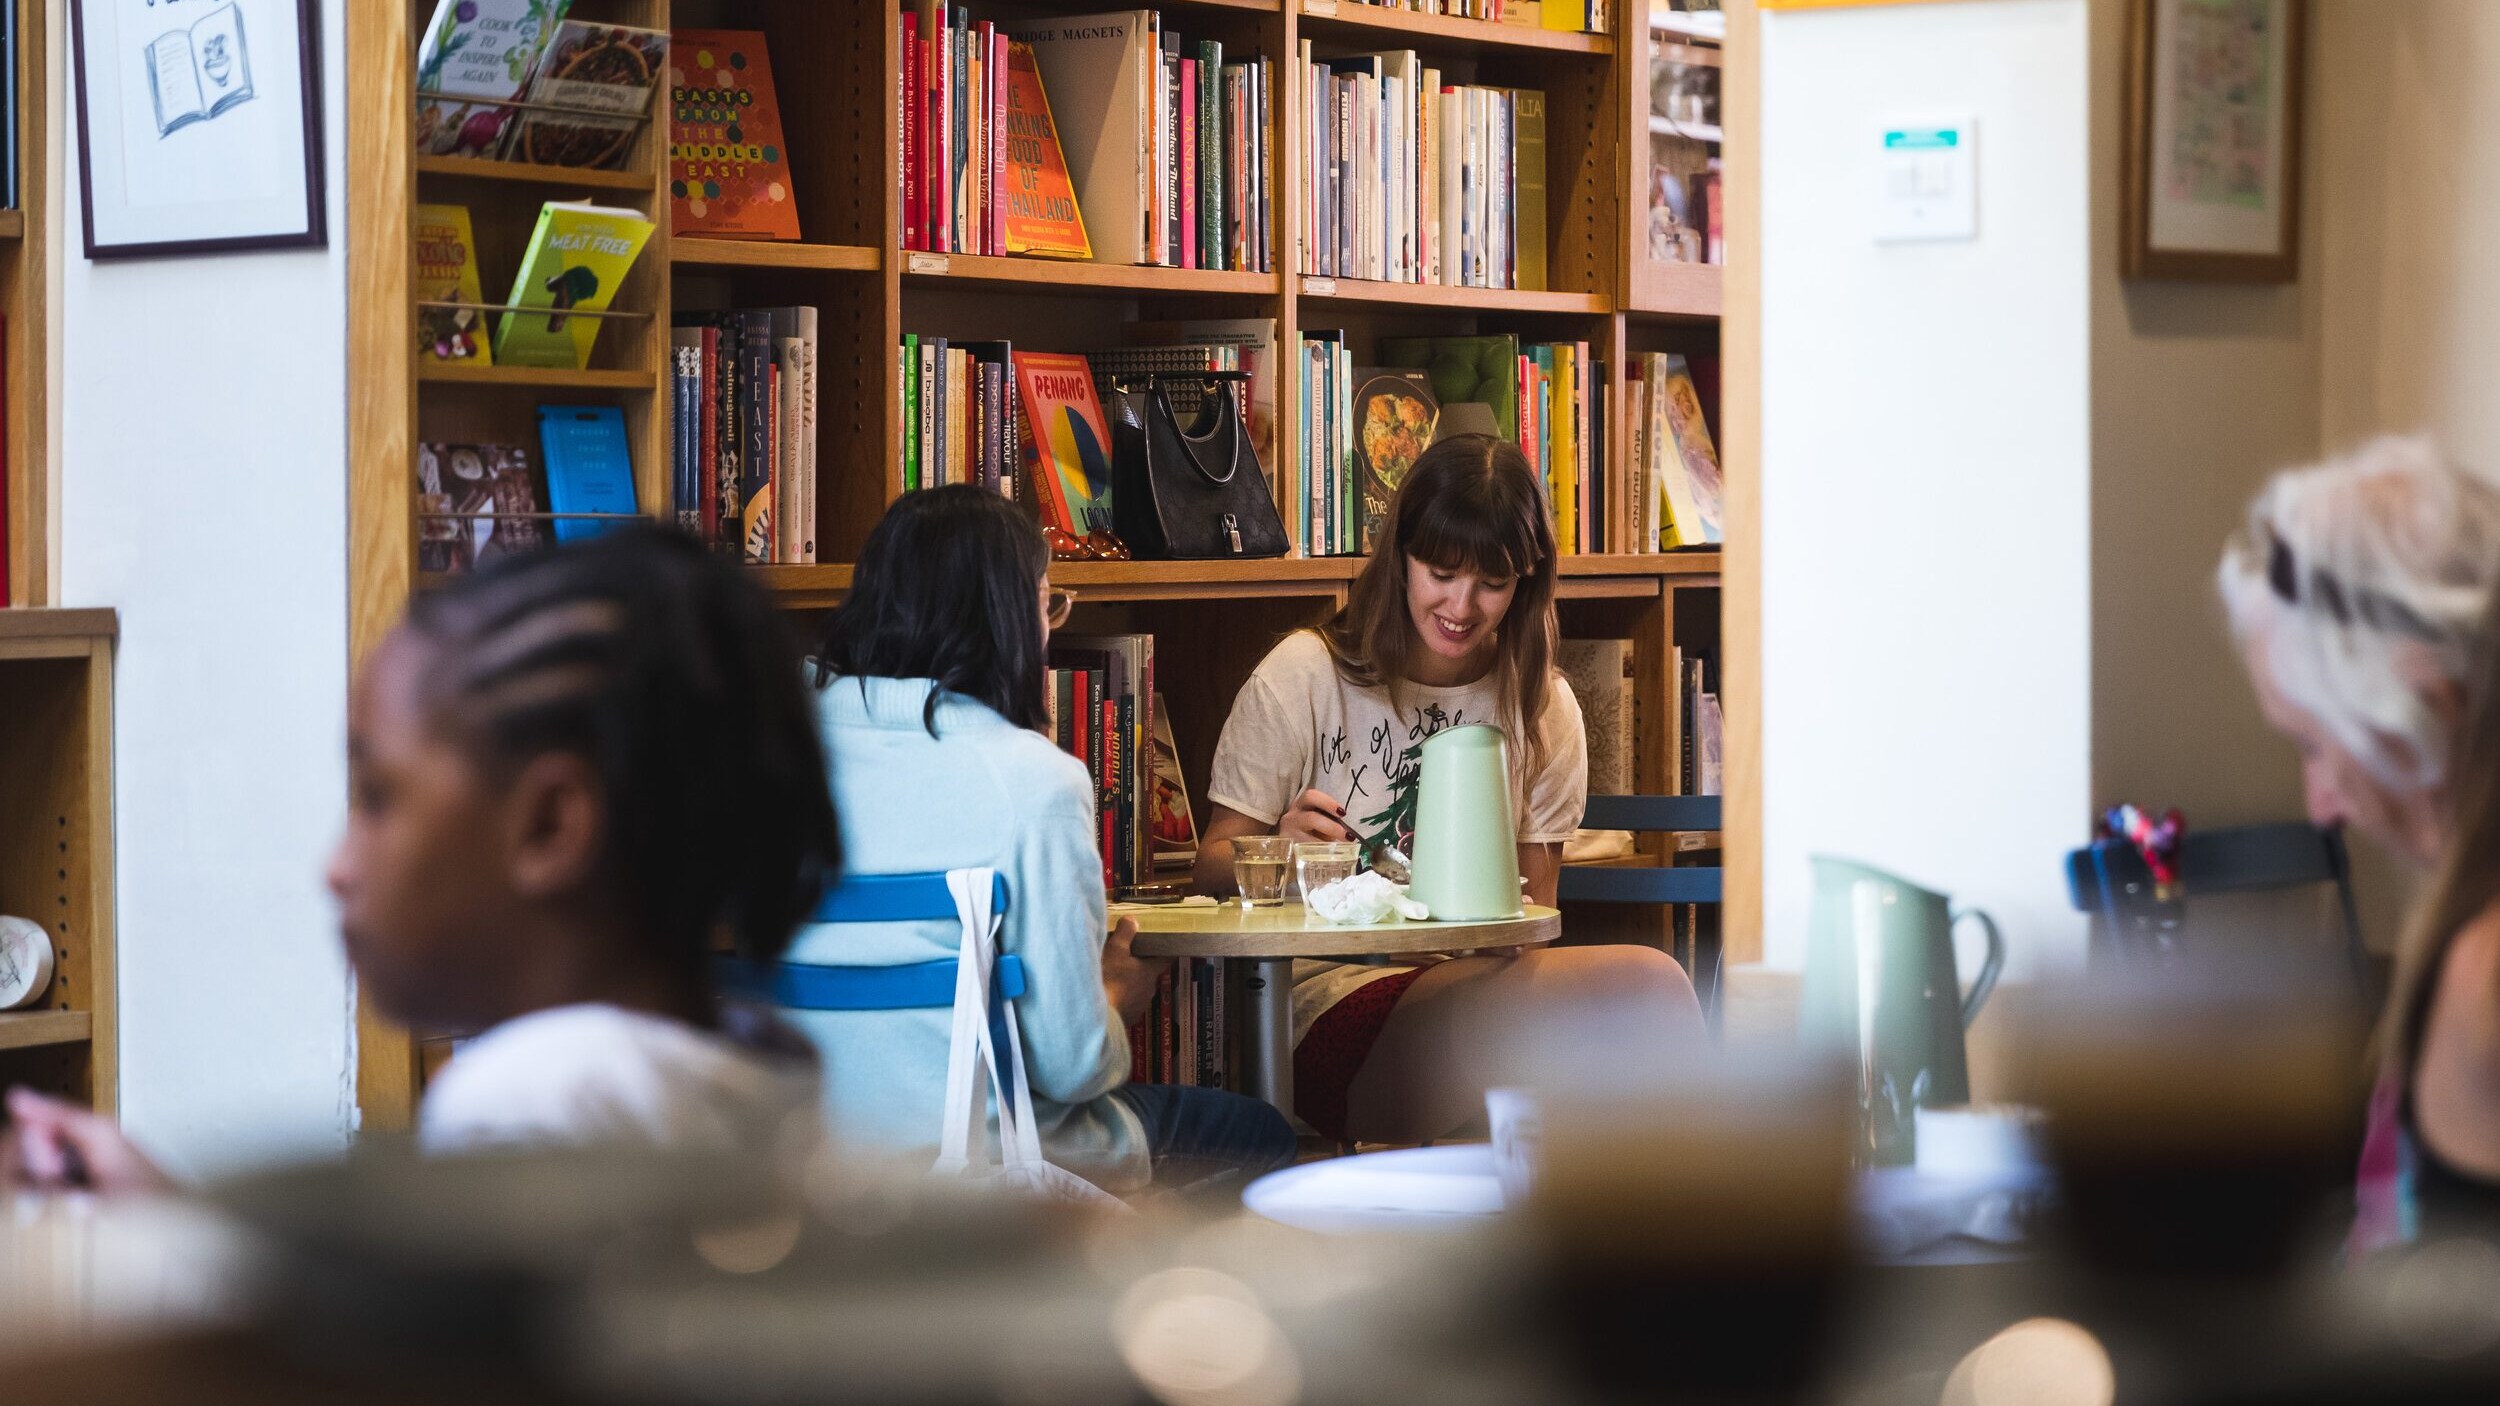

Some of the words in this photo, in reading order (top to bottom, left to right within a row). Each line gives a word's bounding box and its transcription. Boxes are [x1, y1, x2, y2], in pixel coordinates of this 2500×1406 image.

[479, 18, 513, 32] COOK
[1062, 26, 1124, 41] MAGNETS
[479, 36, 497, 48] TO
[907, 29, 915, 57] Same
[458, 51, 503, 66] INSPIRE
[459, 70, 499, 83] AGAIN
[907, 59, 915, 88] Same
[675, 90, 750, 104] EASTS
[1341, 91, 1349, 118] PETER
[1515, 99, 1543, 118] ALIA
[678, 109, 737, 122] FROM
[1007, 111, 1052, 139] NKING
[682, 128, 724, 140] THE
[905, 111, 914, 155] Different
[980, 119, 988, 170] Monsoon
[995, 103, 1006, 173] maenam
[1169, 107, 1178, 165] Northern
[1341, 120, 1349, 162] HOWARD
[670, 145, 761, 159] MIDDLE
[1184, 115, 1194, 216] MANDALAY
[688, 166, 745, 179] EAST
[905, 162, 914, 175] by
[1020, 167, 1039, 191] OF
[980, 172, 988, 208] Winds
[1169, 167, 1178, 222] Thailand
[548, 235, 592, 251] MEAT
[590, 236, 633, 255] FREE
[726, 360, 735, 442] Salmagundi
[1034, 374, 1085, 401] PENANG
[1314, 378, 1322, 408] SOUTH
[753, 356, 762, 477] FEAST
[925, 380, 933, 435] busaba
[990, 370, 998, 443] INDONESIAN
[1314, 409, 1322, 445] AFRICAN
[1634, 429, 1642, 463] MUY
[990, 447, 998, 479] FOOD
[1314, 447, 1322, 495] COOKBOOK
[1365, 497, 1388, 515] The
[1632, 471, 1641, 529] BUENO
[1080, 507, 1113, 531] LOCA
[1092, 732, 1101, 774] Complete
[1112, 732, 1121, 794] NOODLES
